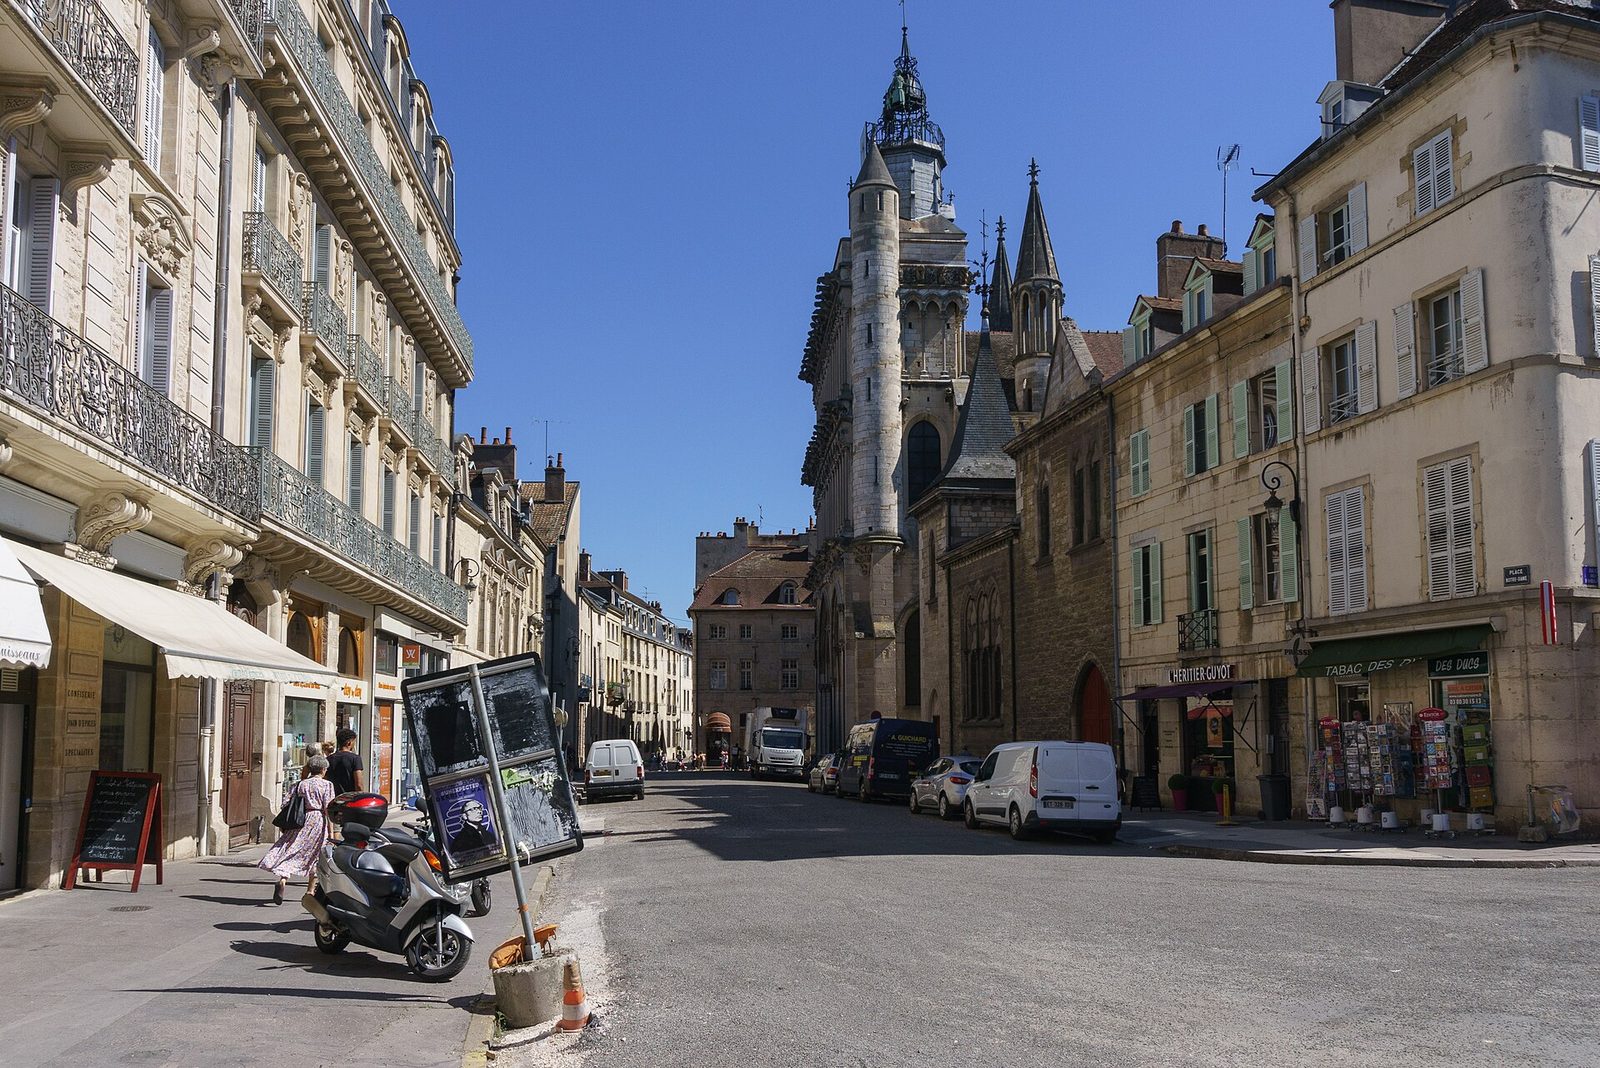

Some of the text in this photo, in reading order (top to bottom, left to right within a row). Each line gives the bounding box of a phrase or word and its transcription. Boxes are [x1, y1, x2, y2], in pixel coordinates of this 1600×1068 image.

[1284, 648, 1313, 656] PRSSE
[1325, 663, 1363, 677] TABAC
[1368, 659, 1395, 672] DES
[1435, 659, 1453, 672] DES
[1456, 657, 1480, 671] DUCS
[67, 689, 96, 699] CONFISERIE
